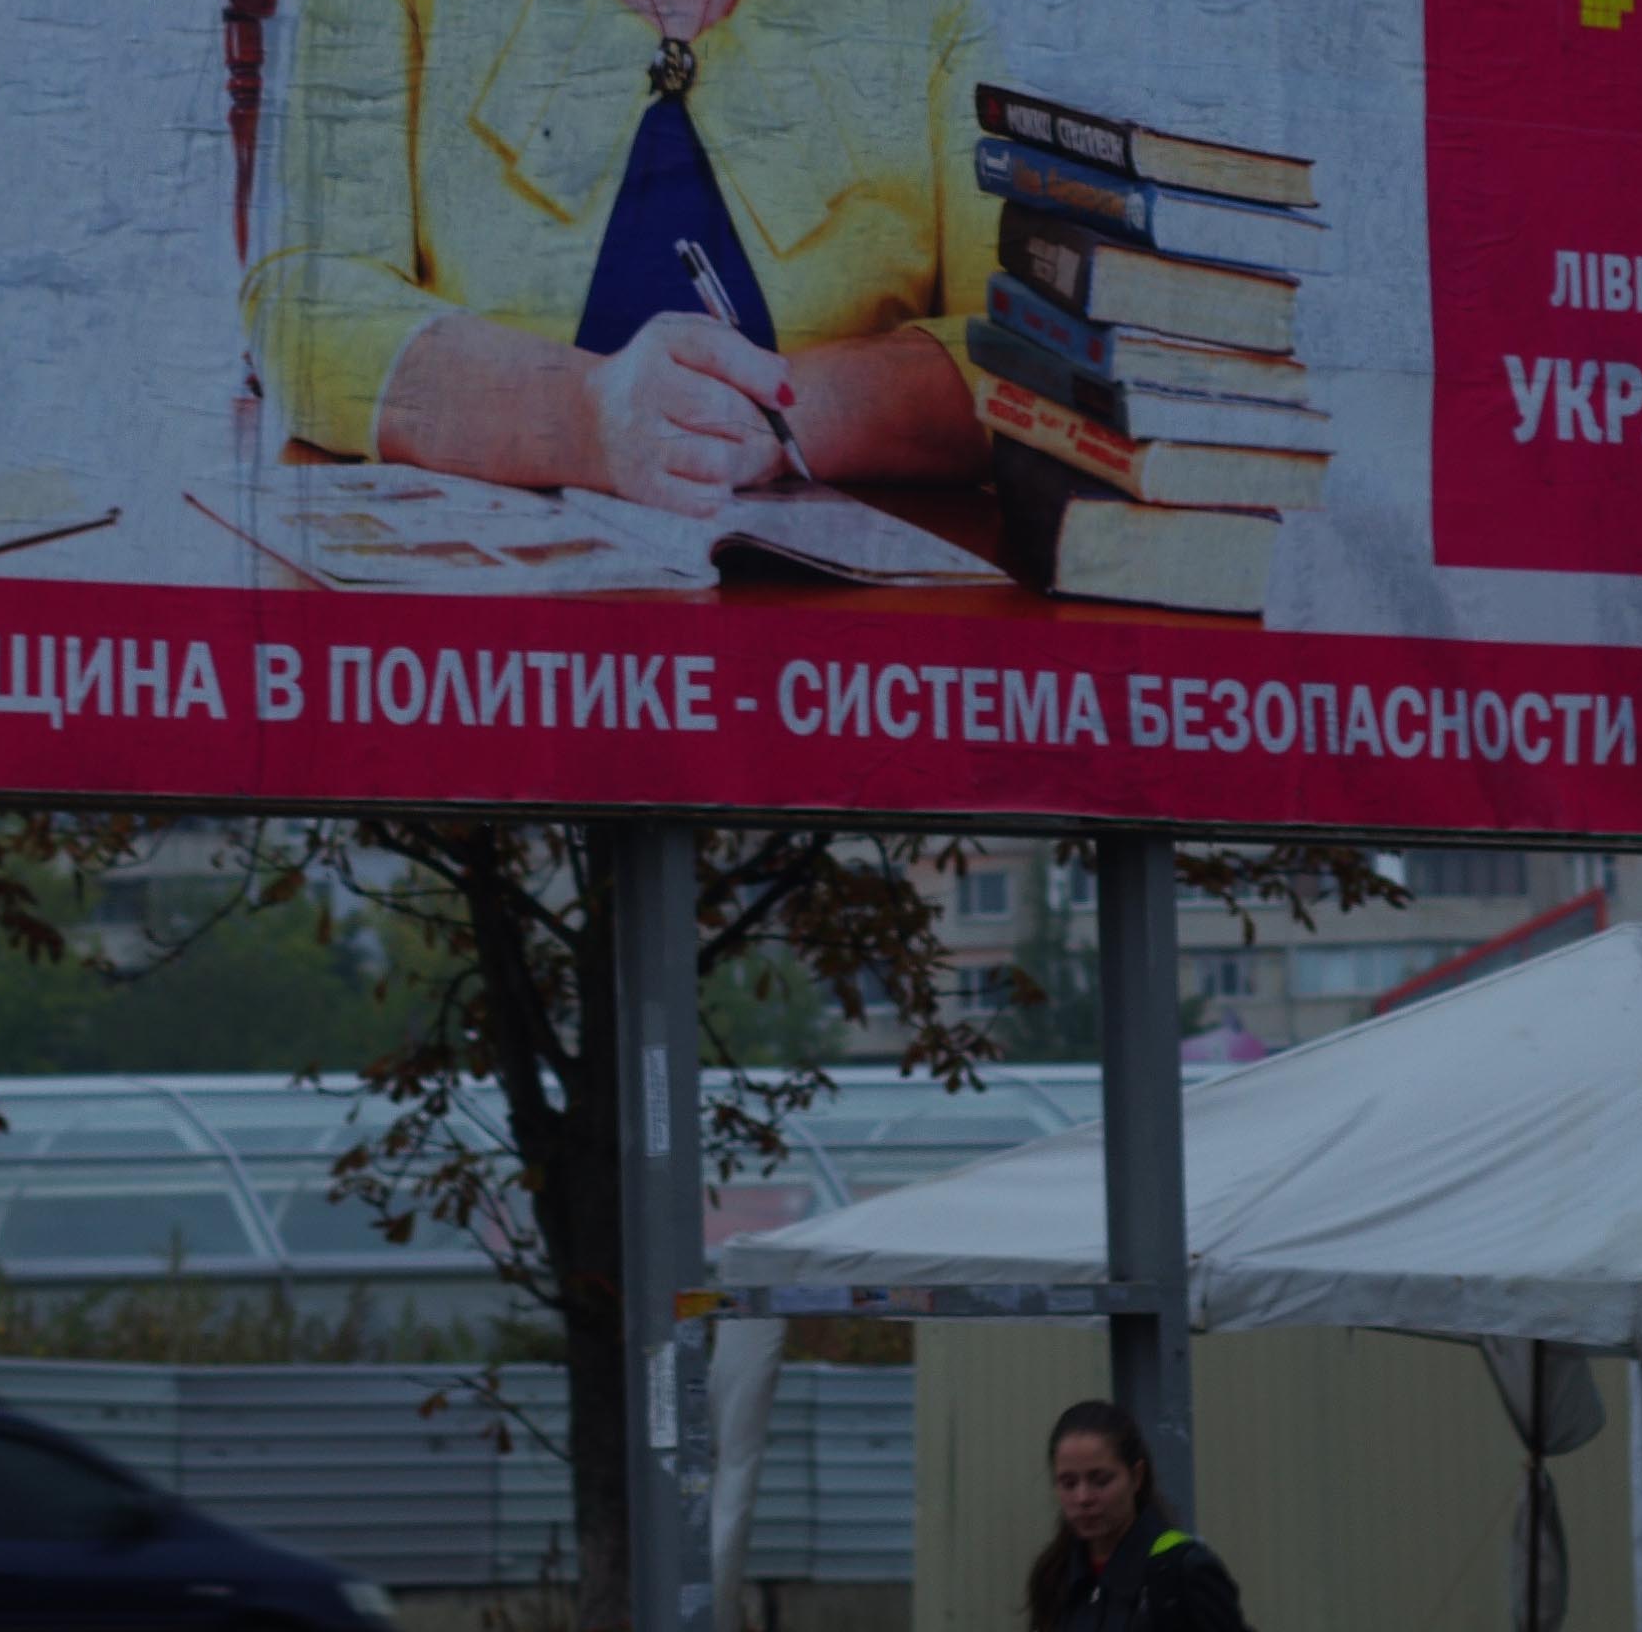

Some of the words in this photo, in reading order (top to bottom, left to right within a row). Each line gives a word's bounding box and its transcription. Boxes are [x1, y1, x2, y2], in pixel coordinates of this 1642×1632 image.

[253, 643, 305, 721] В
[329, 644, 719, 732] ПОЛИТИКЕ
[777, 659, 1109, 747] СИСТЕМА
[1127, 674, 1637, 767] БЕЗОПАСНОСТИ
